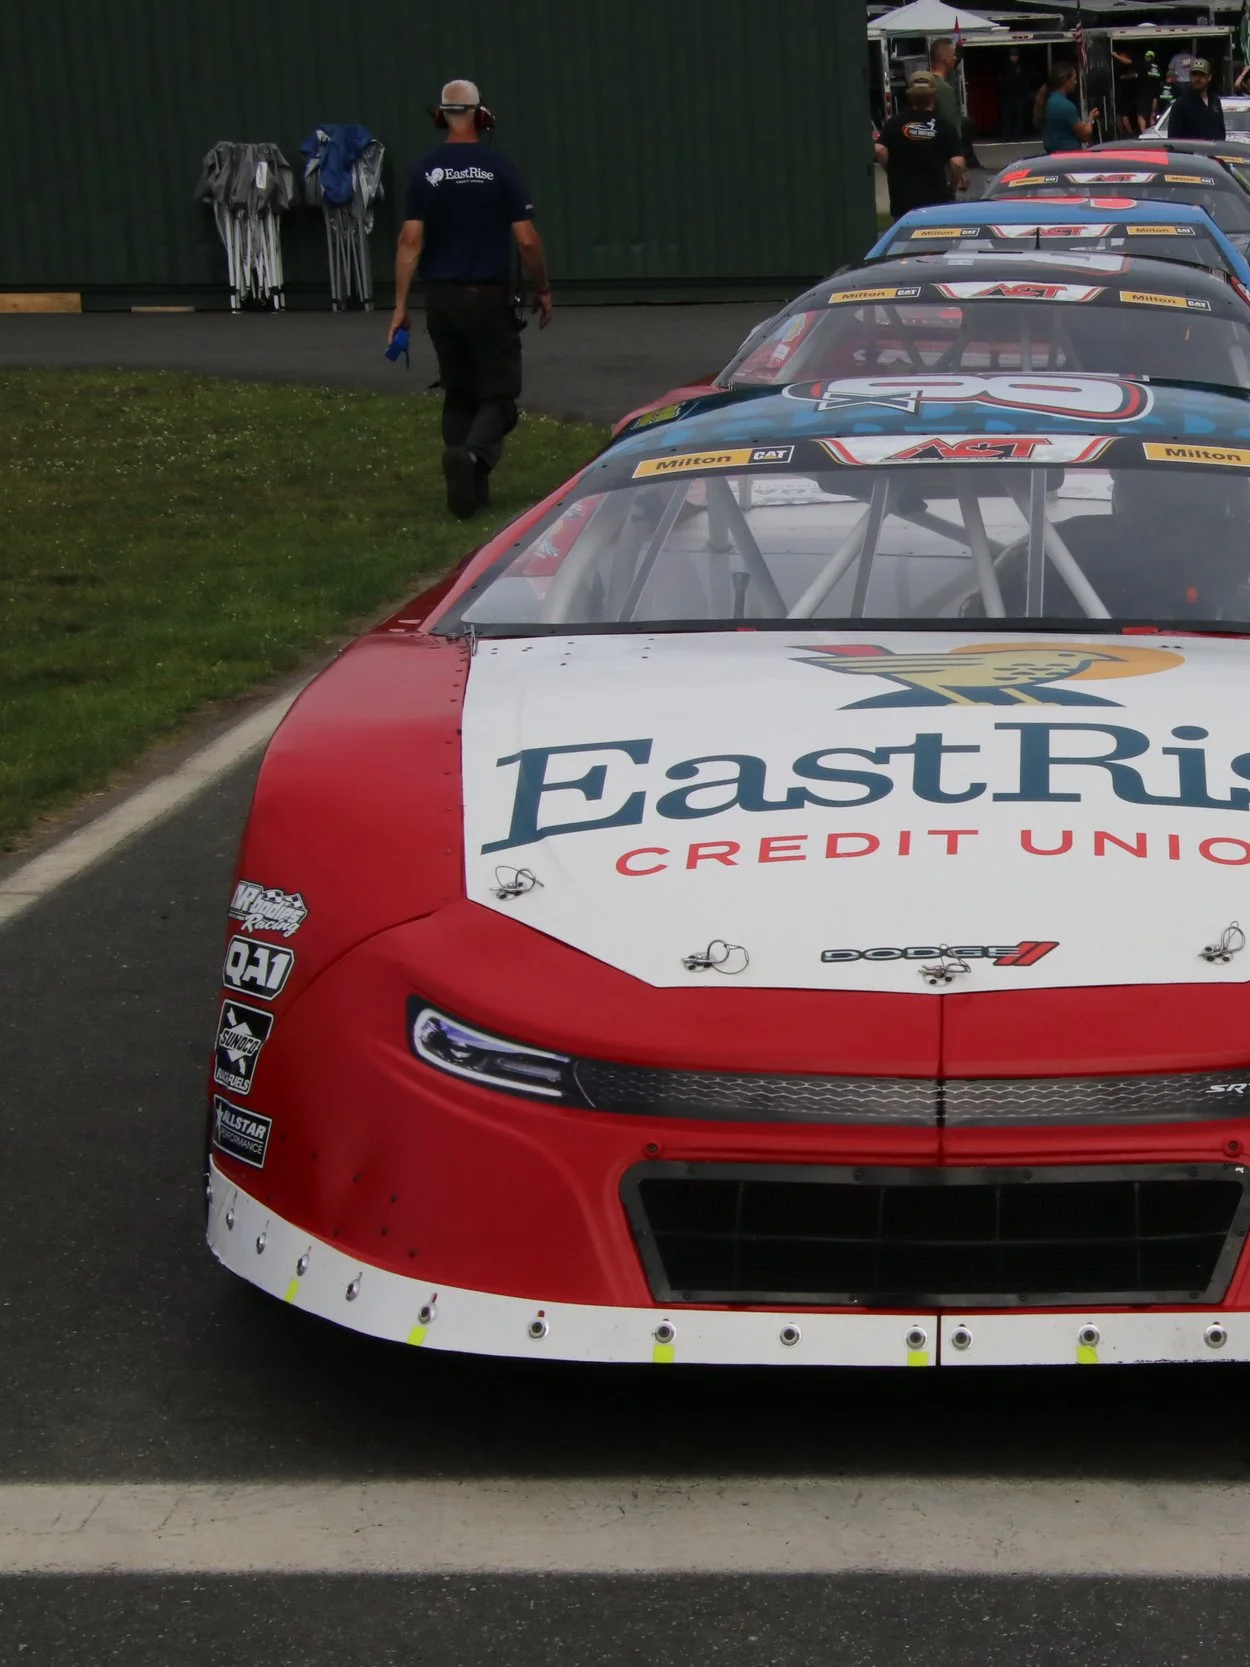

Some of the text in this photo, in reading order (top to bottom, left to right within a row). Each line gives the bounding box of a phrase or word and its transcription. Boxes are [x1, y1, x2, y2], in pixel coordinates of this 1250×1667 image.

[444, 167, 494, 180] EastRise
[920, 229, 954, 237] Milton
[1135, 226, 1194, 235] Milton CAT
[840, 288, 917, 299] Milton CAT
[972, 283, 1068, 298] ACT
[1131, 293, 1209, 310] Milton CAT
[886, 438, 1052, 459] ACT
[1164, 447, 1242, 462] Milton
[656, 449, 788, 470] Milton CAT
[615, 829, 979, 876] CREDIT
[241, 913, 300, 937] Racing
[821, 946, 1021, 963] DODGE
[225, 940, 291, 990] QA1
[220, 1029, 259, 1055] SUNOCO
[229, 1073, 250, 1091] FUELS
[222, 1109, 266, 1140] ALLSTAR
[220, 1125, 263, 1155] PERFORMANCE
